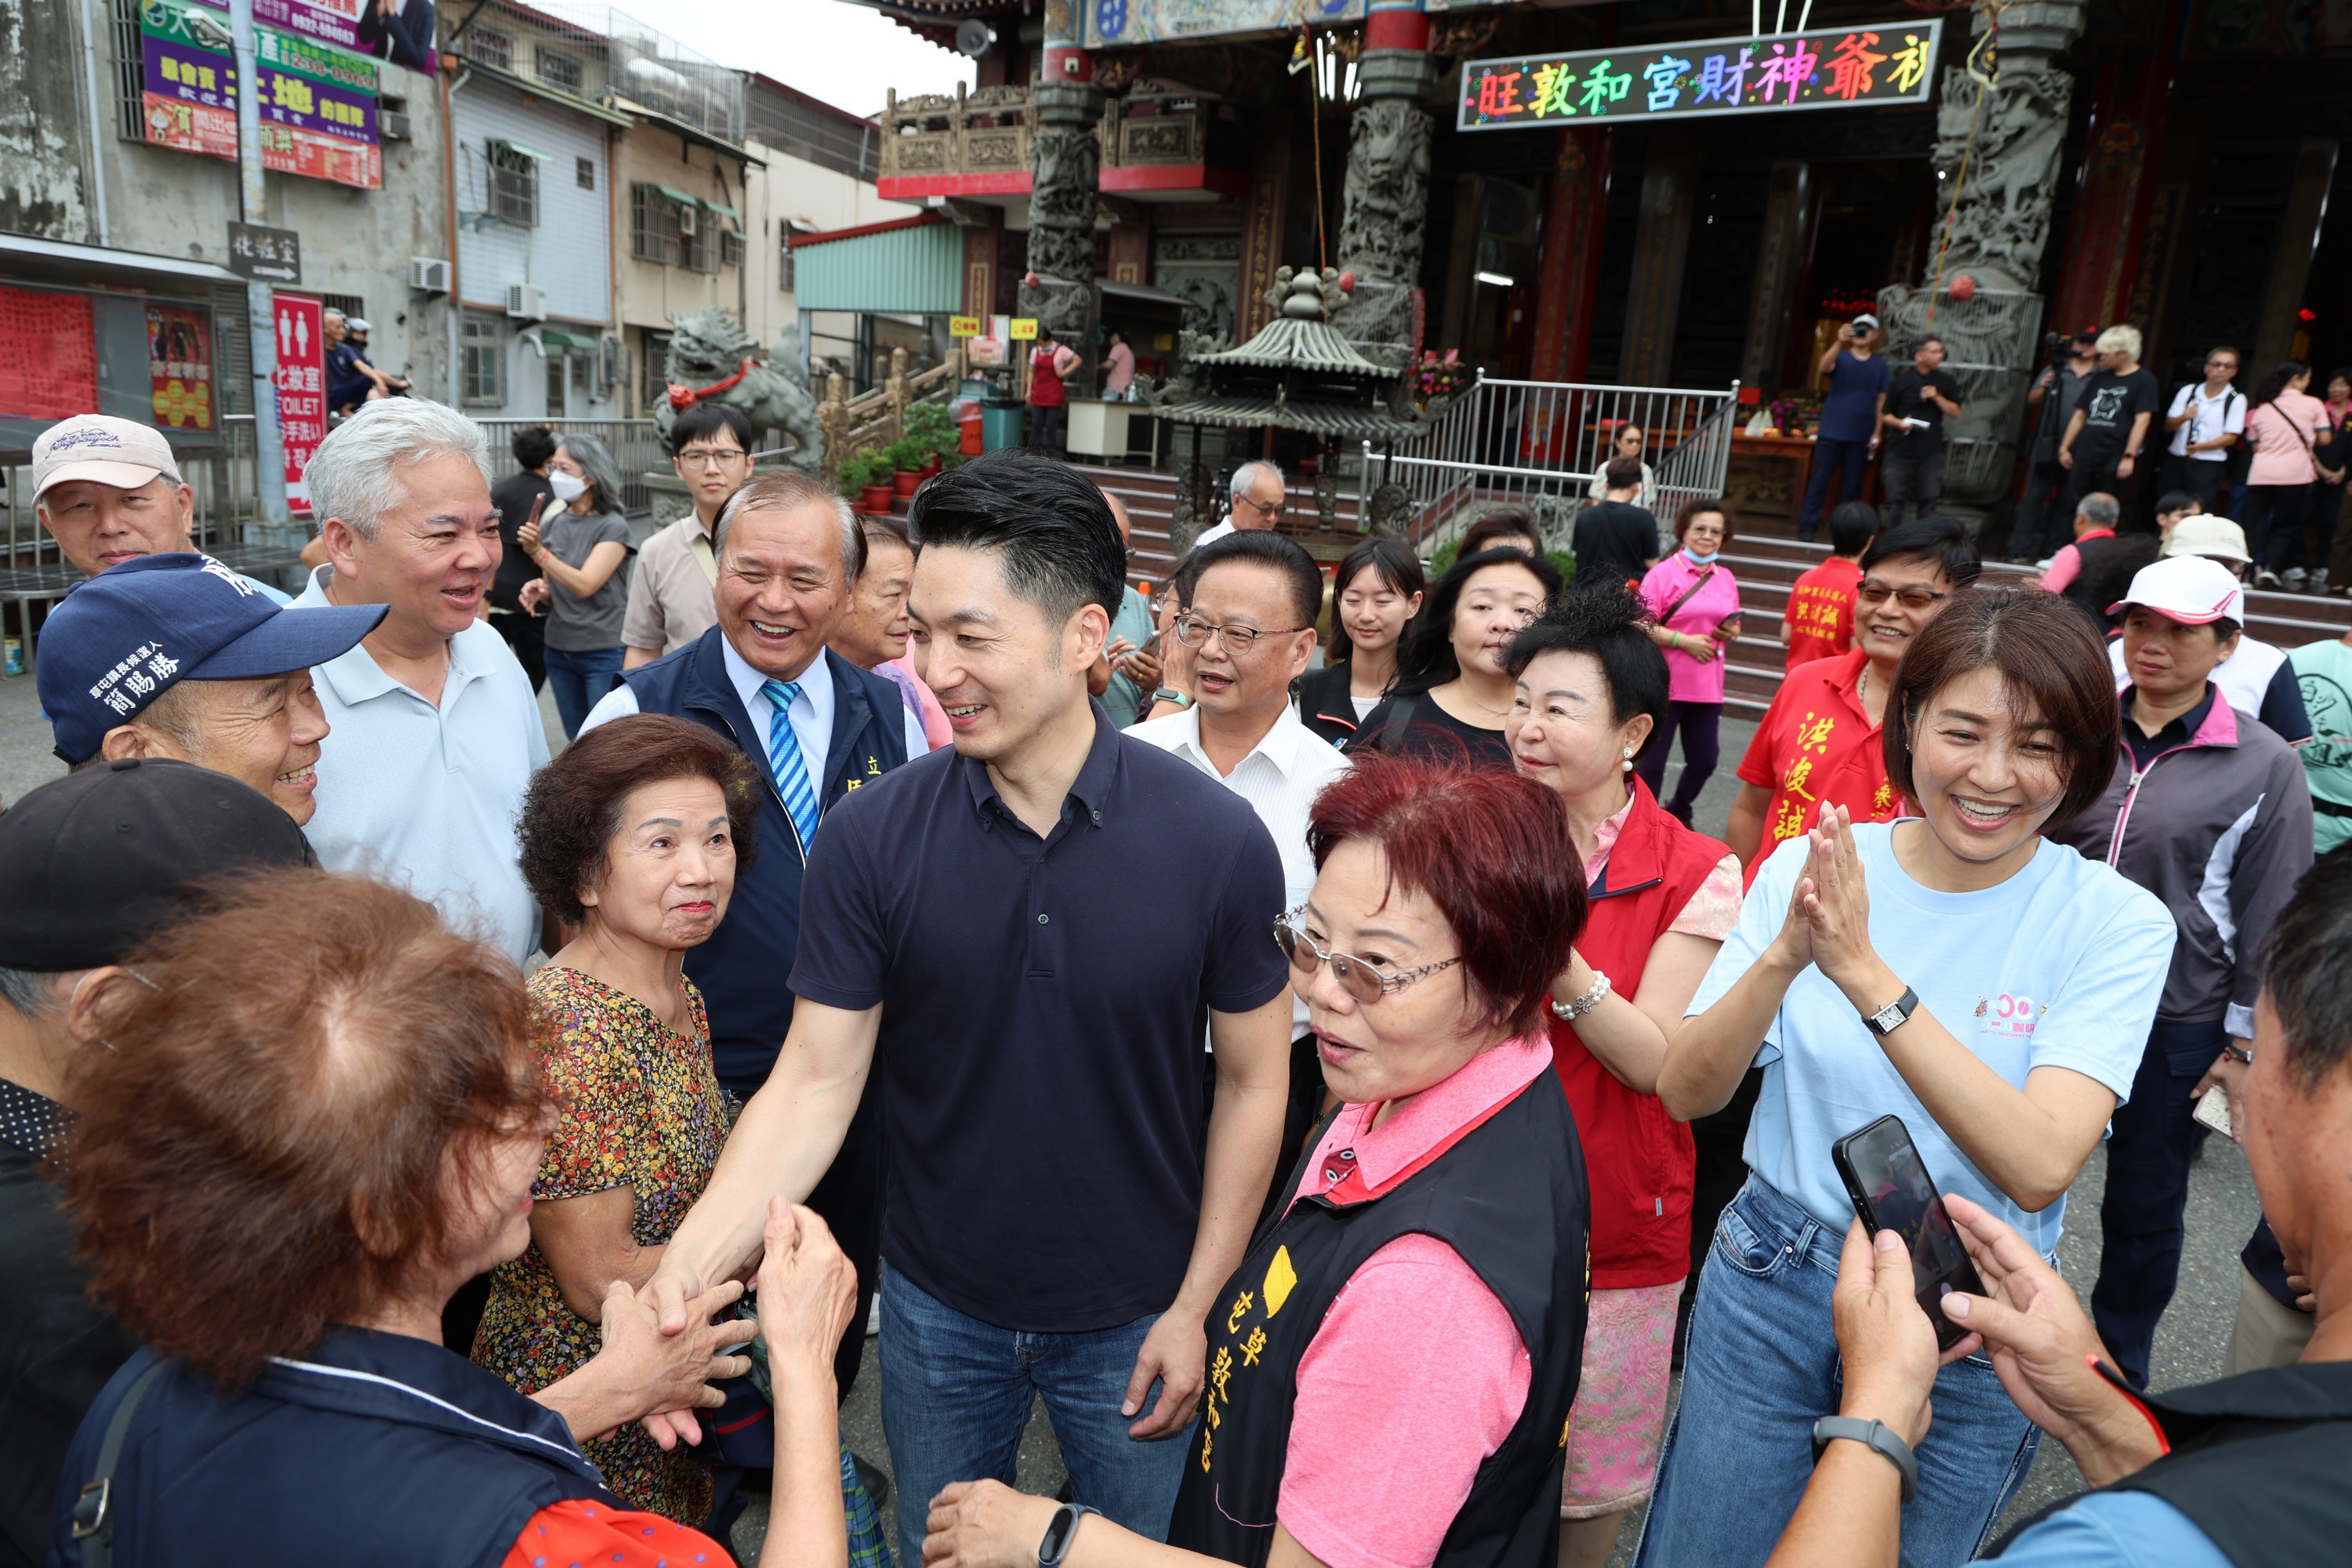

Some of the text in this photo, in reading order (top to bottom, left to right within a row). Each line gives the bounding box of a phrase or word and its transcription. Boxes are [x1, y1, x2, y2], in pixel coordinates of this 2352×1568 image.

[89, 641, 163, 699] 草屯鎮長候選人
[103, 652, 180, 716] 簡賜勝
[1773, 711, 1835, 840] 洪浚誠
